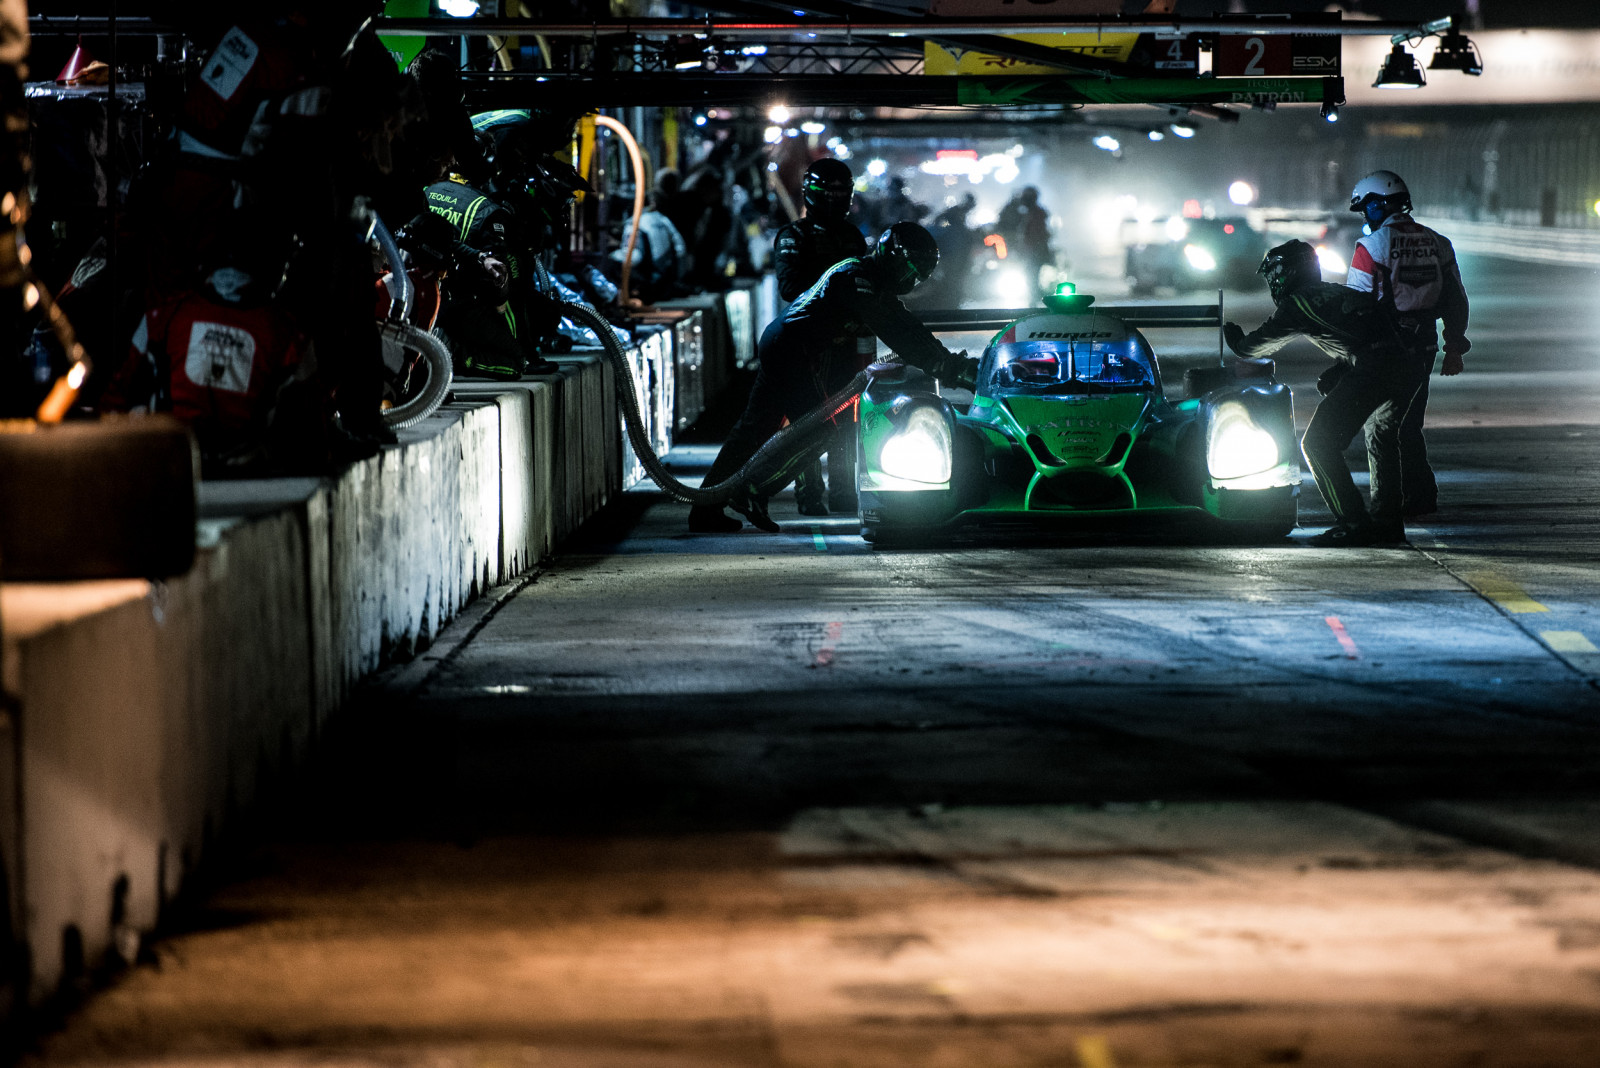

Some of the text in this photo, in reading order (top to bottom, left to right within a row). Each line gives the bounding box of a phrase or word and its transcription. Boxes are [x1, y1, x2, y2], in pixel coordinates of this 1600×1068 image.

[1166, 39, 1183, 60] 4
[1243, 37, 1265, 75] 2
[1292, 56, 1337, 67] ESM
[1247, 80, 1290, 89] TEQUILA
[1231, 88, 1305, 103] PATRÓN
[428, 192, 458, 205] TEQUILA
[1028, 331, 1112, 339] Honda
